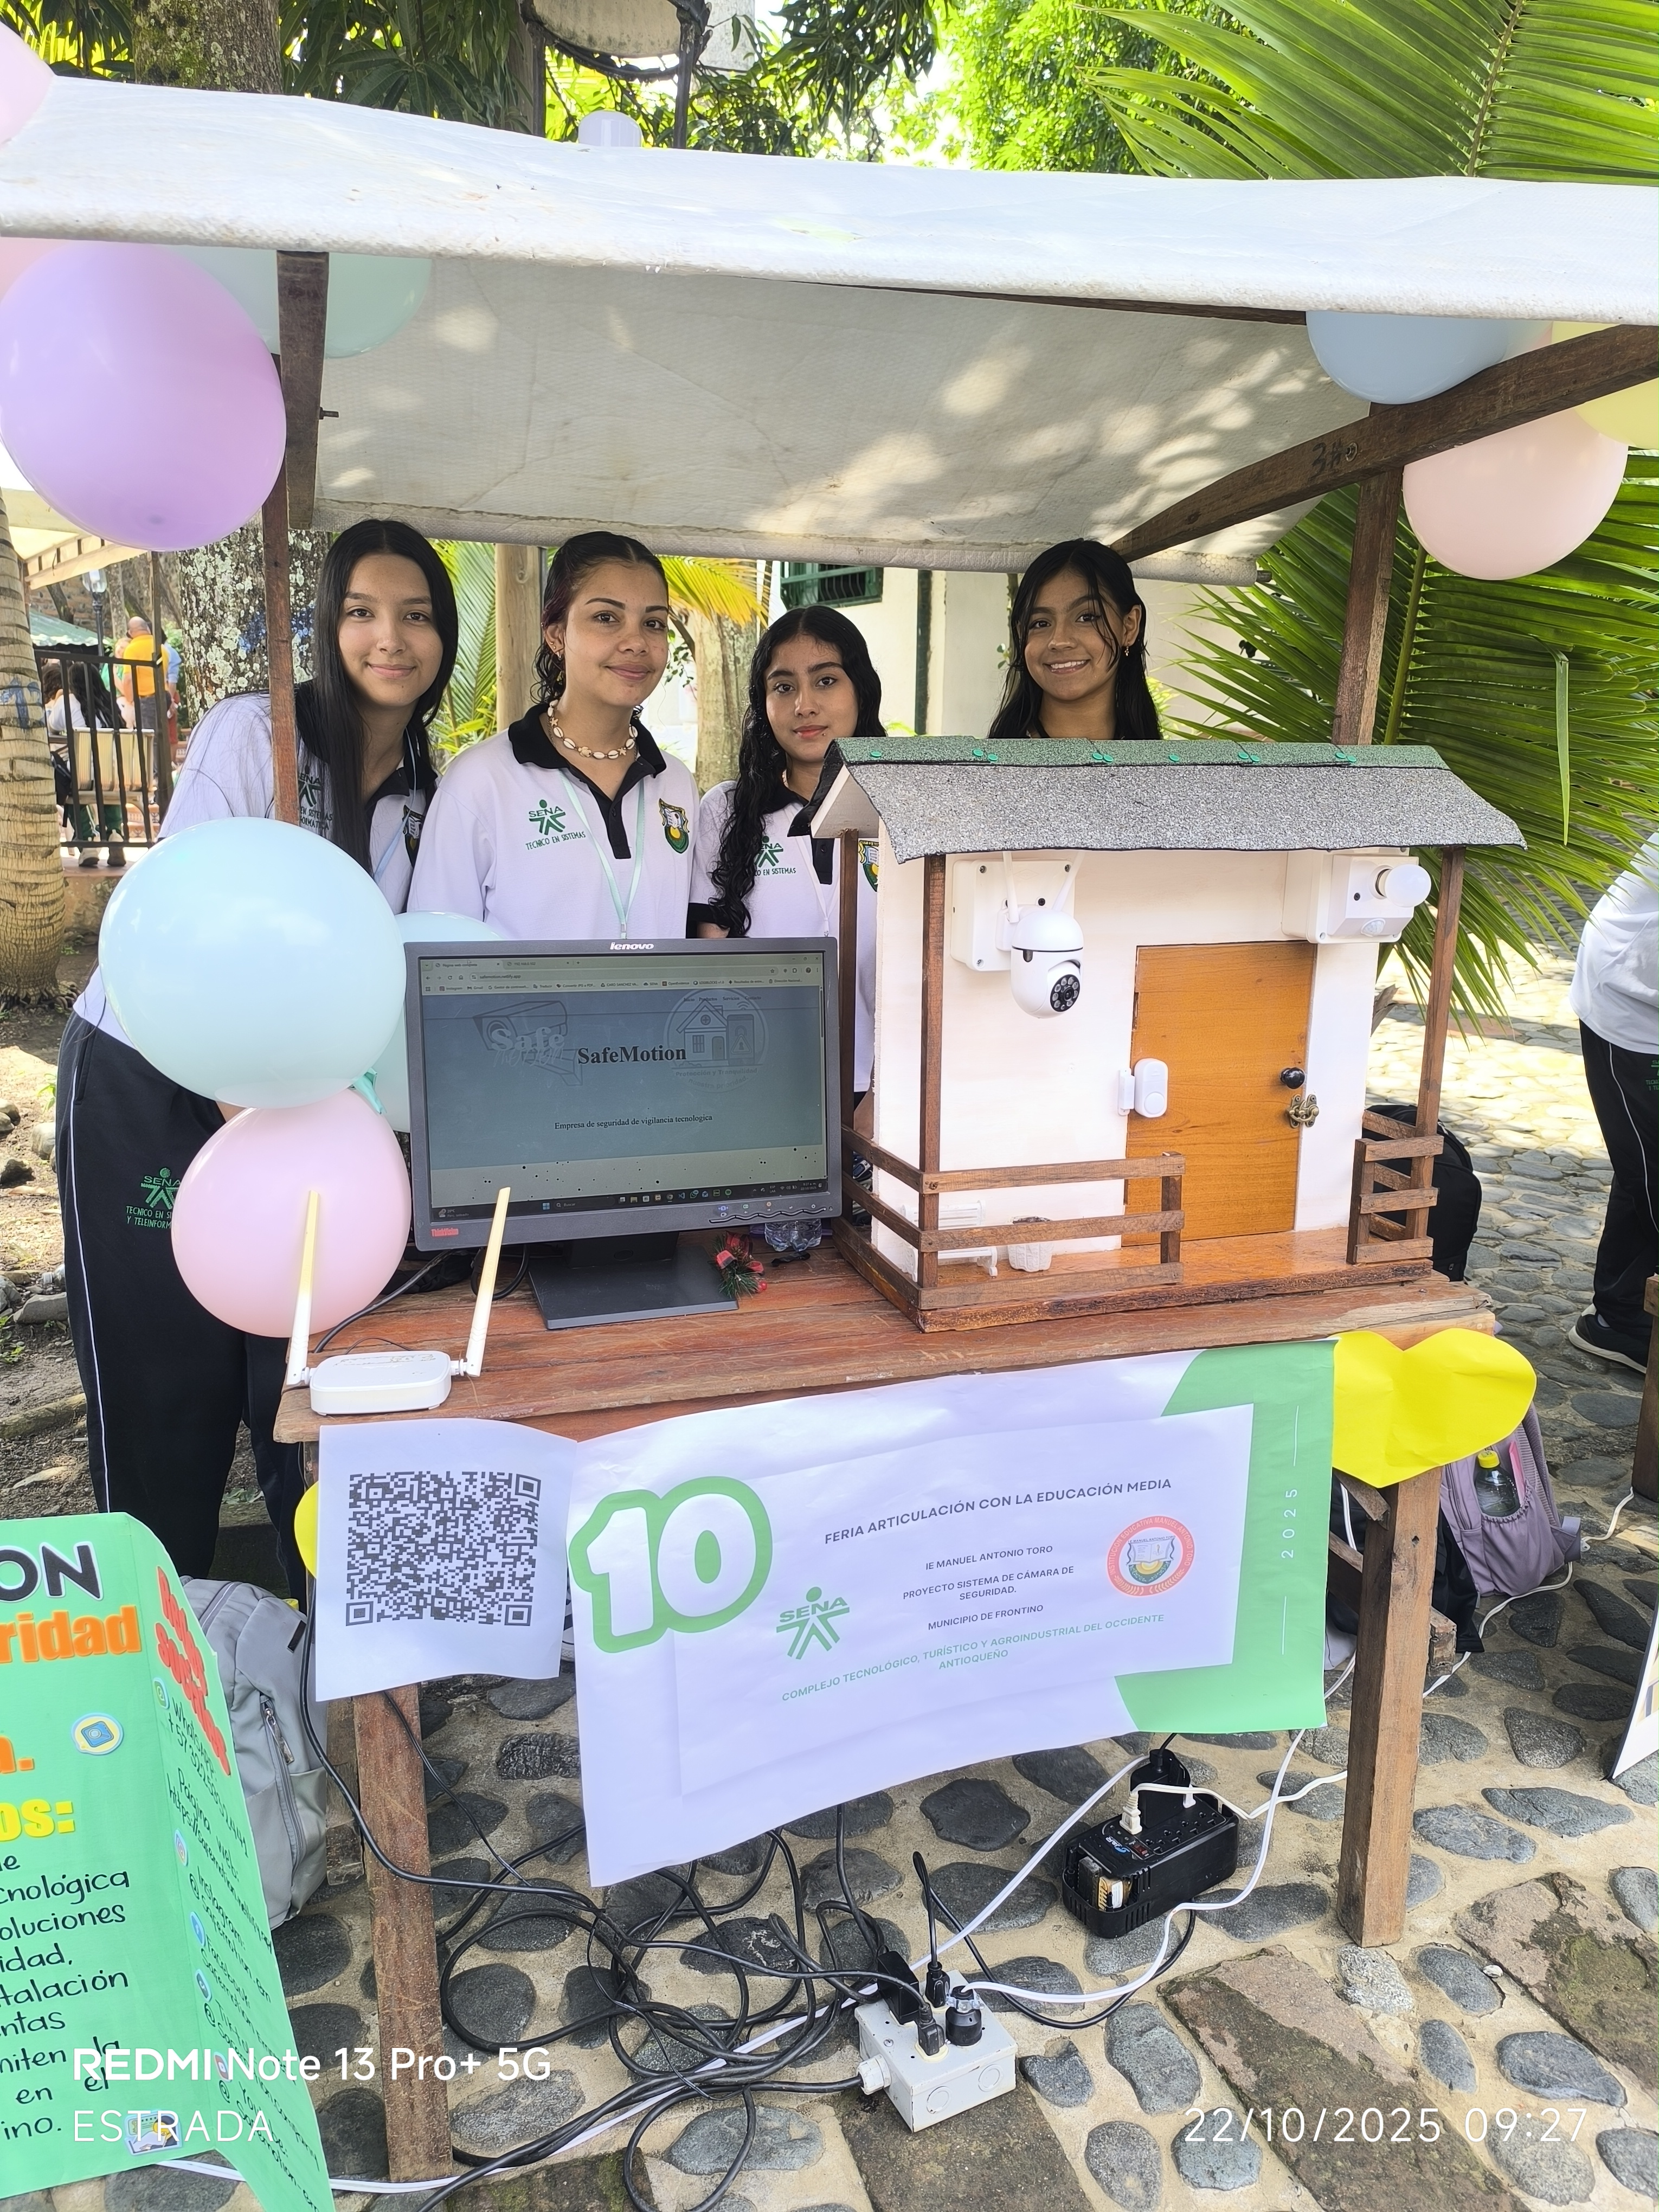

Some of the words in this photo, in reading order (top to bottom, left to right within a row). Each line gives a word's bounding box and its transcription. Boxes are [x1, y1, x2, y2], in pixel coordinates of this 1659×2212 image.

[299, 773, 321, 786] ENA
[308, 809, 333, 821] SISTEAS
[529, 806, 563, 817] SENA
[525, 838, 550, 850] TECNICO
[551, 835, 560, 844] EN
[561, 831, 586, 841] SISTEMAS
[610, 942, 654, 950] lenovo
[491, 1026, 564, 1051] Safe
[578, 1045, 687, 1064] SafeMotion
[555, 1122, 584, 1130] Empresa
[596, 1118, 629, 1129] seguridad
[641, 1116, 674, 1126] vigilancia
[675, 1114, 713, 1123] tecnologica
[144, 1175, 181, 1186] SENA
[126, 1206, 152, 1217] TECNICO
[155, 1210, 164, 1219] EN
[127, 1215, 131, 1224] Y
[134, 1217, 172, 1229] TELEINFORM
[431, 1228, 459, 1237] ThinkVision
[825, 1526, 864, 1544] FERIA
[867, 1500, 975, 1533] ARTICULACIÓN
[979, 1496, 1011, 1509] CON
[1015, 1494, 1033, 1504] LA
[1037, 1483, 1123, 1502] EDUCACIÓN
[1127, 1478, 1172, 1493] MEDIA
[1281, 1489, 1298, 1559] 2025
[1120, 1518, 1154, 1539] EDUCATIVA
[1154, 1517, 1178, 1529] MANUEL
[1176, 1526, 1193, 1549] ANTONIO
[1185, 1549, 1193, 1566] TORO
[569, 1477, 772, 1652] 10
[926, 1562, 934, 1570] IE
[936, 1555, 977, 1568] MANUEL
[979, 1549, 1024, 1561] ANTONIO
[1026, 1546, 1053, 1555] TORO
[0, 1542, 102, 1602] ON
[903, 1583, 955, 1599] PROYECTO
[957, 1576, 999, 1589] SISTEMA
[1002, 1574, 1014, 1582] DE
[1017, 1568, 1059, 1579] CÁMARA
[1062, 1566, 1074, 1574] DE
[960, 1586, 1017, 1600] SEGURIDAD.
[779, 1597, 848, 1623] SENA
[928, 1615, 978, 1630] MUNICIPIO
[981, 1612, 993, 1621] DE
[995, 1605, 1044, 1618] FRONTINO
[782, 1677, 840, 1701] COMPLEJO
[843, 1655, 921, 1683] TECNOLÓGICO,
[923, 1642, 978, 1660] TURÍSTICO
[981, 1640, 988, 1648] Y
[991, 1626, 1081, 1647] AGROINDUSTRIAL
[1083, 1623, 1103, 1632] DEL
[1105, 1614, 1165, 1629] OCCIDENTE
[938, 1649, 1008, 1670] ANTIOQUEÑO
[0, 1855, 21, 1870] e
[0, 1905, 126, 1940] oluciones
[15, 2087, 53, 2104] en
[84, 2067, 109, 2091] el
[1, 2117, 62, 2140] ino.
